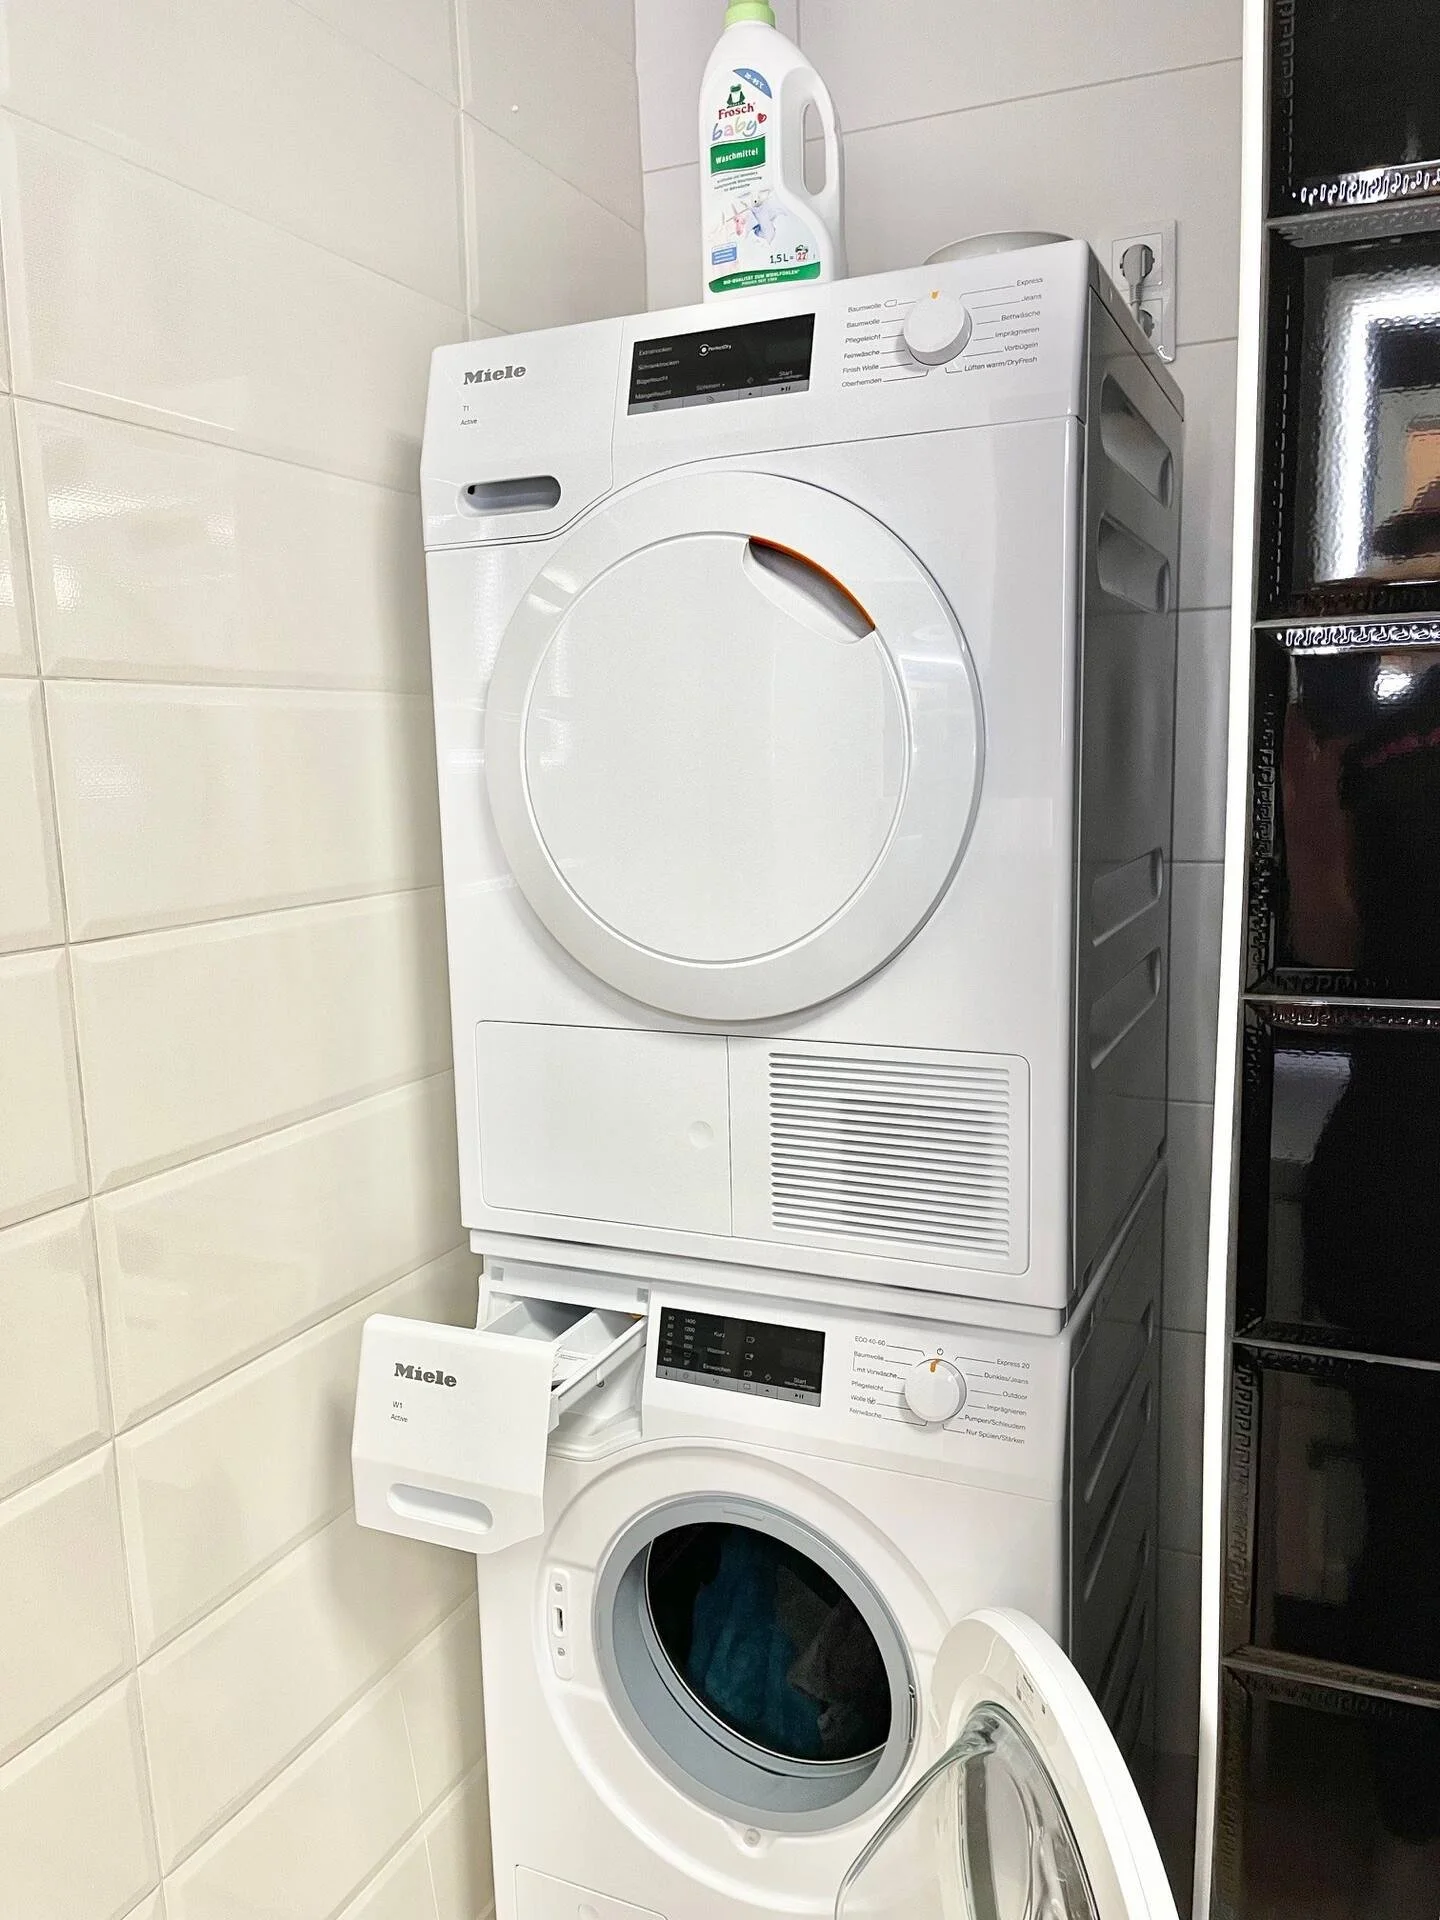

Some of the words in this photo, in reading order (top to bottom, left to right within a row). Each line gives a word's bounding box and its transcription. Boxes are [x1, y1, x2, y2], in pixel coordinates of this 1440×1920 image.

[718, 103, 754, 120] Frosch
[712, 116, 757, 141] baby
[715, 147, 759, 165] Waschmittel
[769, 253, 782, 264] 1,5
[783, 253, 789, 262] L
[1016, 278, 1043, 287] Express
[1021, 293, 1042, 302] Jeans
[847, 303, 882, 313] Baumwolle
[1001, 310, 1041, 321] Bettwäsche
[846, 318, 880, 329] Baumwolle
[995, 327, 1040, 338] Imprägnieren
[845, 334, 881, 344] Pflegeleicht
[1004, 342, 1039, 352] Vorbügeln
[843, 350, 880, 360] Feinwäsche
[842, 366, 861, 374] Finish
[862, 364, 879, 372] Wolle
[964, 363, 985, 372] Lüften
[986, 356, 1038, 369] warm/DryFresh
[463, 365, 527, 386] Miele
[841, 378, 882, 388] Oberhemden
[463, 404, 470, 412] T1
[460, 418, 478, 426] Active
[854, 1335, 868, 1344] ECO
[868, 1338, 886, 1347] 40-60
[854, 1351, 884, 1361] Baumwolle
[996, 1358, 1020, 1369] Express
[1021, 1362, 1031, 1370] 20
[394, 1362, 457, 1388] Miele
[866, 1368, 898, 1379] Vorwäsche
[851, 1380, 884, 1391] Pflegeleicht
[850, 1394, 866, 1403] Wolle
[1002, 1390, 1028, 1400] Outdoor
[392, 1400, 403, 1409] W1
[986, 1403, 1027, 1416] Imprägnieren
[390, 1413, 408, 1423] Active
[849, 1407, 882, 1418] Feinwäsche
[964, 1414, 1026, 1430] Pumpen/Schleudern
[965, 1428, 978, 1436] Nur
